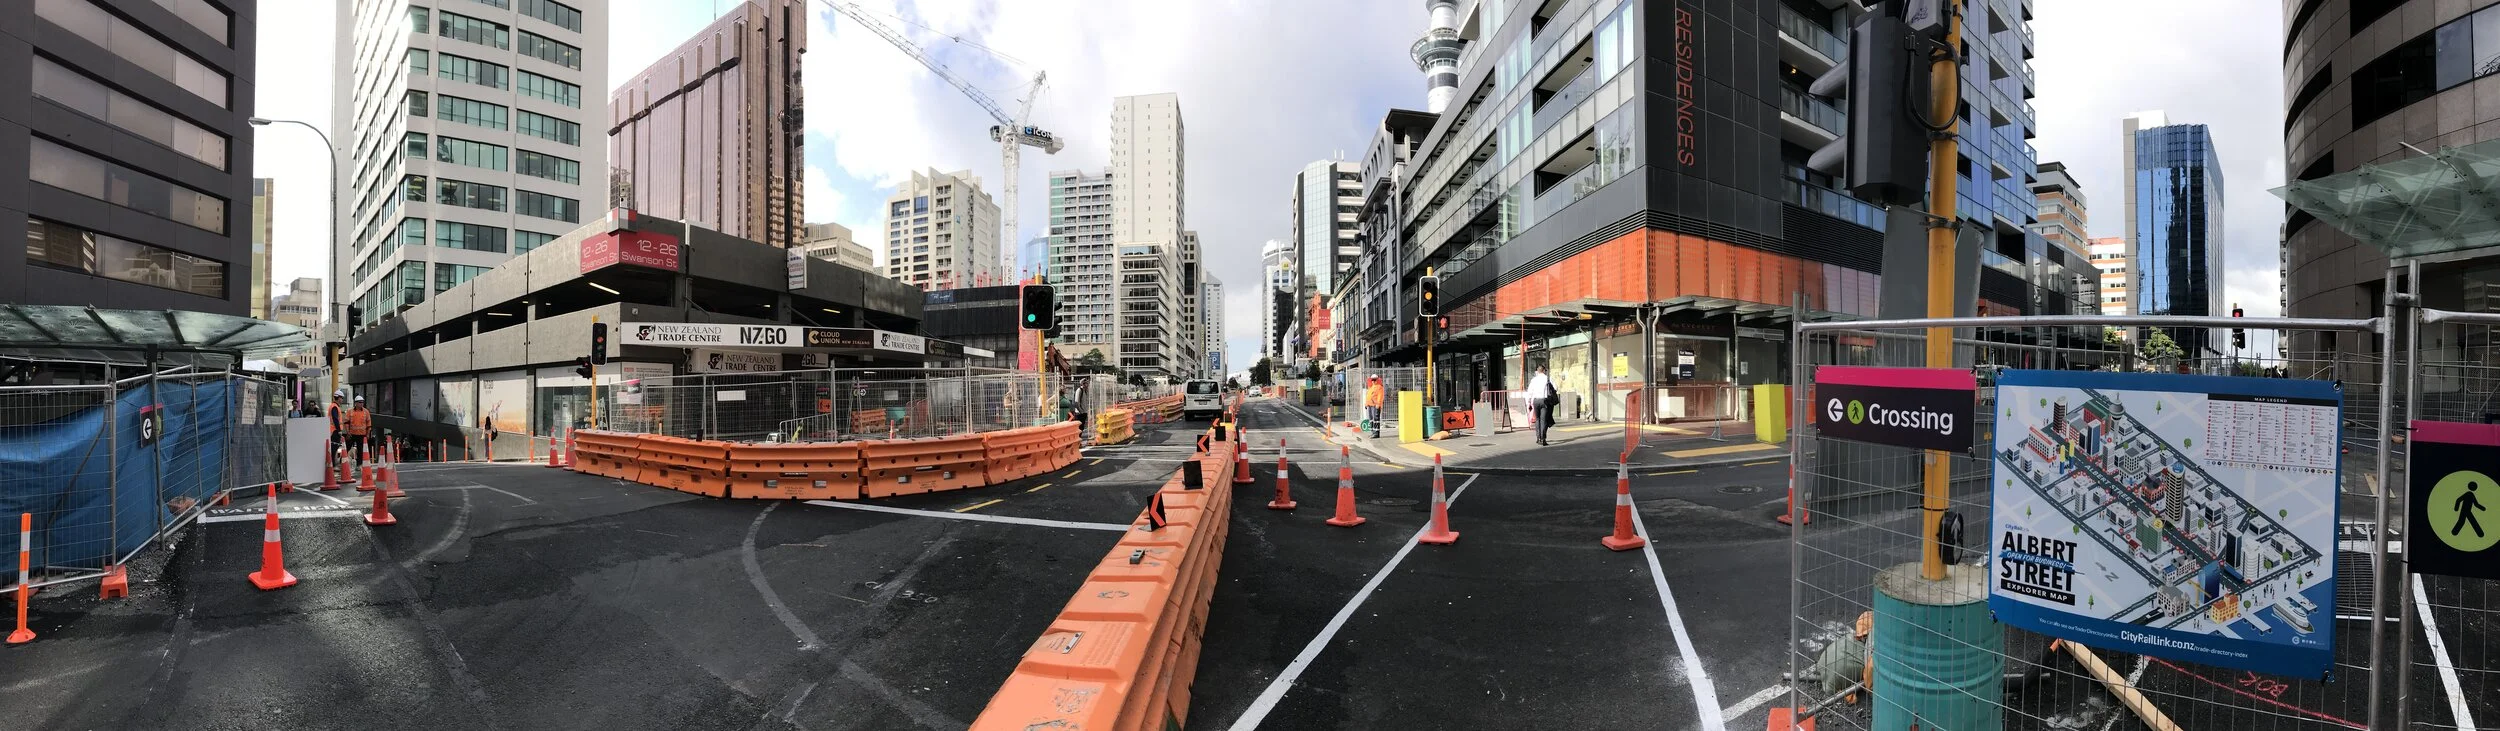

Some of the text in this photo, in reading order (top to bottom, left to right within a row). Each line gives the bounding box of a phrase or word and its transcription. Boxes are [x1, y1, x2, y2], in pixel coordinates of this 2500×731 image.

[1675, 7, 1695, 168] RESIDENCES
[581, 256, 608, 270] Swanson
[621, 251, 678, 268] Swanson St
[657, 325, 721, 334] NEW ZEALAND
[658, 333, 722, 342] TRADE CENTRE
[891, 341, 920, 351] TRADE CENTRE
[727, 354, 775, 363] NEW ZEALAND
[725, 362, 777, 372] TRADE CENTRE
[1869, 403, 1954, 436] Crossing
[2085, 465, 2137, 504] ALBERT STREET
[2002, 531, 2077, 564] ALBERT
[2006, 551, 2023, 560] OPEN
[2023, 554, 2035, 562] FOR
[2001, 558, 2075, 592] STREET
[2006, 582, 2068, 601] EXPLORER MAP
